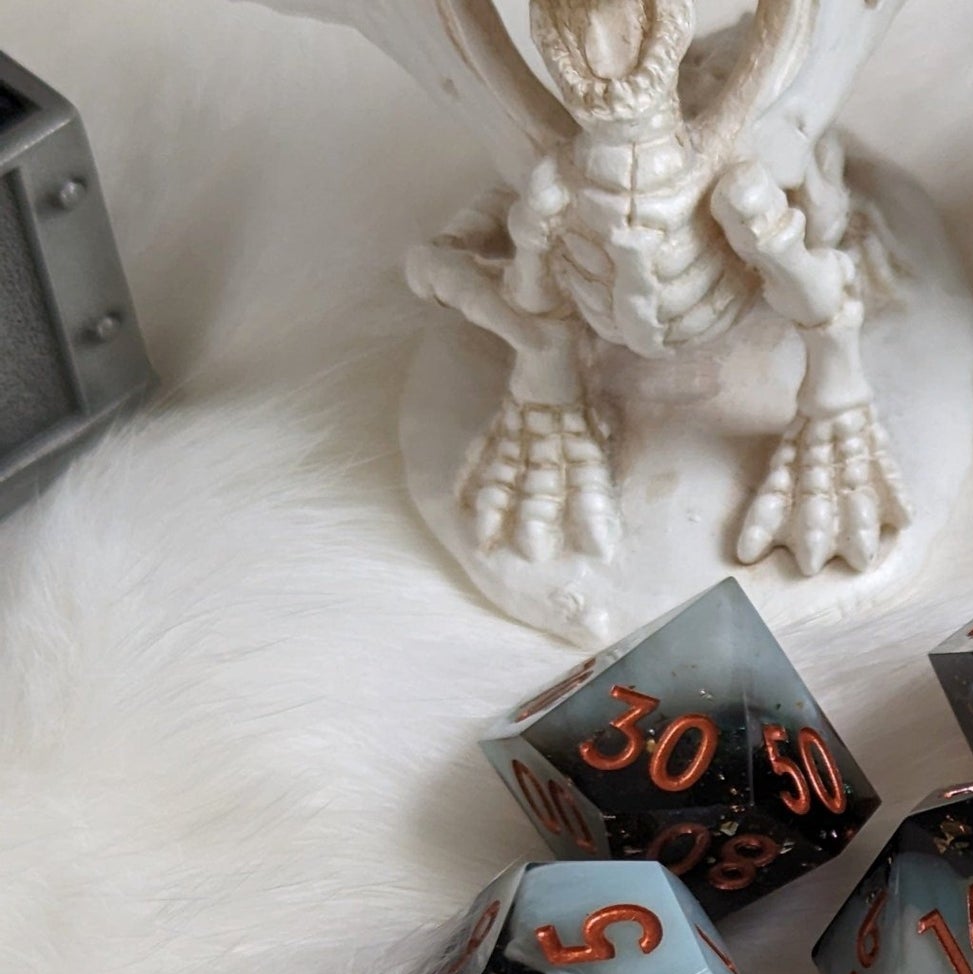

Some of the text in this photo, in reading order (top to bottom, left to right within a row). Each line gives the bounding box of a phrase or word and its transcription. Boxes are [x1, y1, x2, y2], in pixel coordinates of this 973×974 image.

[578, 685, 720, 793] 30
[762, 723, 846, 815] 50
[534, 903, 664, 967] 5
